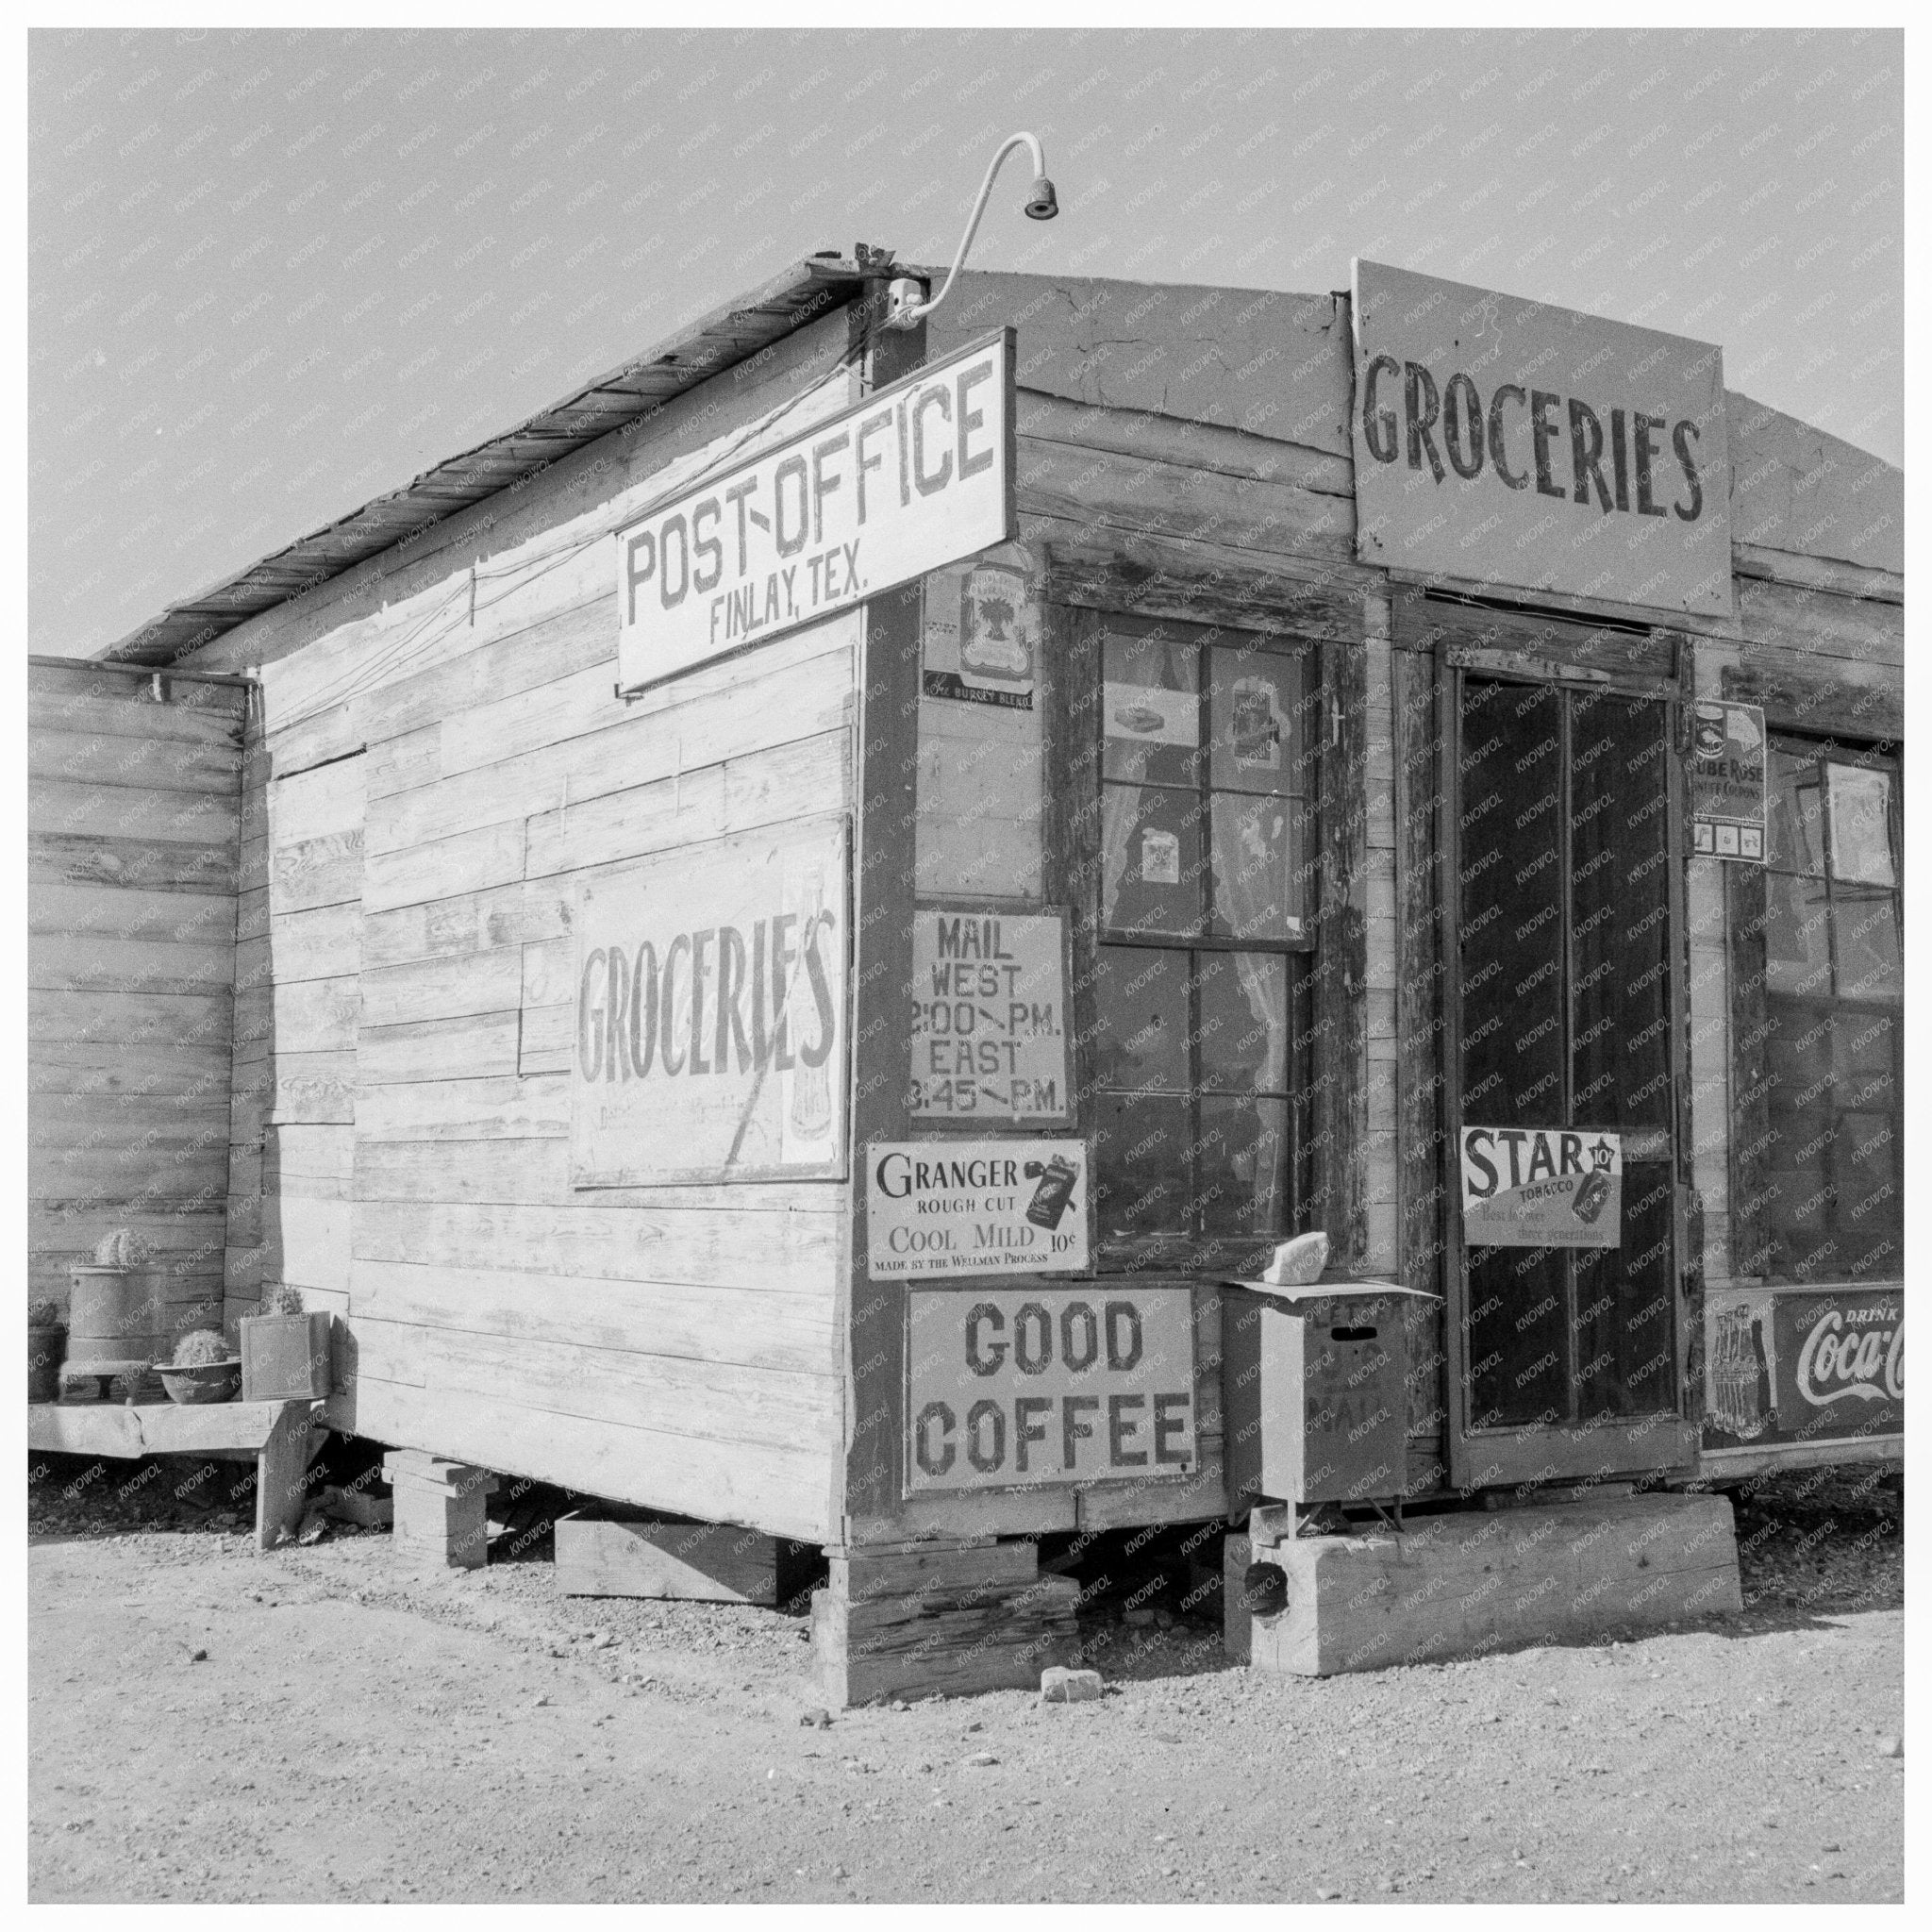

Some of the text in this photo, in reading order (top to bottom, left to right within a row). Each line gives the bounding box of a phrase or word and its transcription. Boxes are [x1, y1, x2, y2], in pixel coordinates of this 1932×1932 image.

[1363, 355, 1703, 522] GROCERIES
[1695, 759, 1727, 777] UBE
[938, 917, 1014, 959] MAIL
[578, 908, 837, 1084] GROCERIES
[931, 962, 1022, 998] WEST
[930, 1040, 1022, 1074] EAST
[876, 1152, 1018, 1199] GRANGER
[1465, 1128, 1585, 1199] STAR
[918, 1197, 1016, 1214] ROUGH CUT
[1520, 1179, 1574, 1203] TOBACCO
[874, 1260, 907, 1272] MADE
[928, 1258, 948, 1269] THE
[1845, 1307, 1899, 1323] DRINK
[965, 1301, 1143, 1377] GOOD
[916, 1392, 1192, 1476] COFFEE
